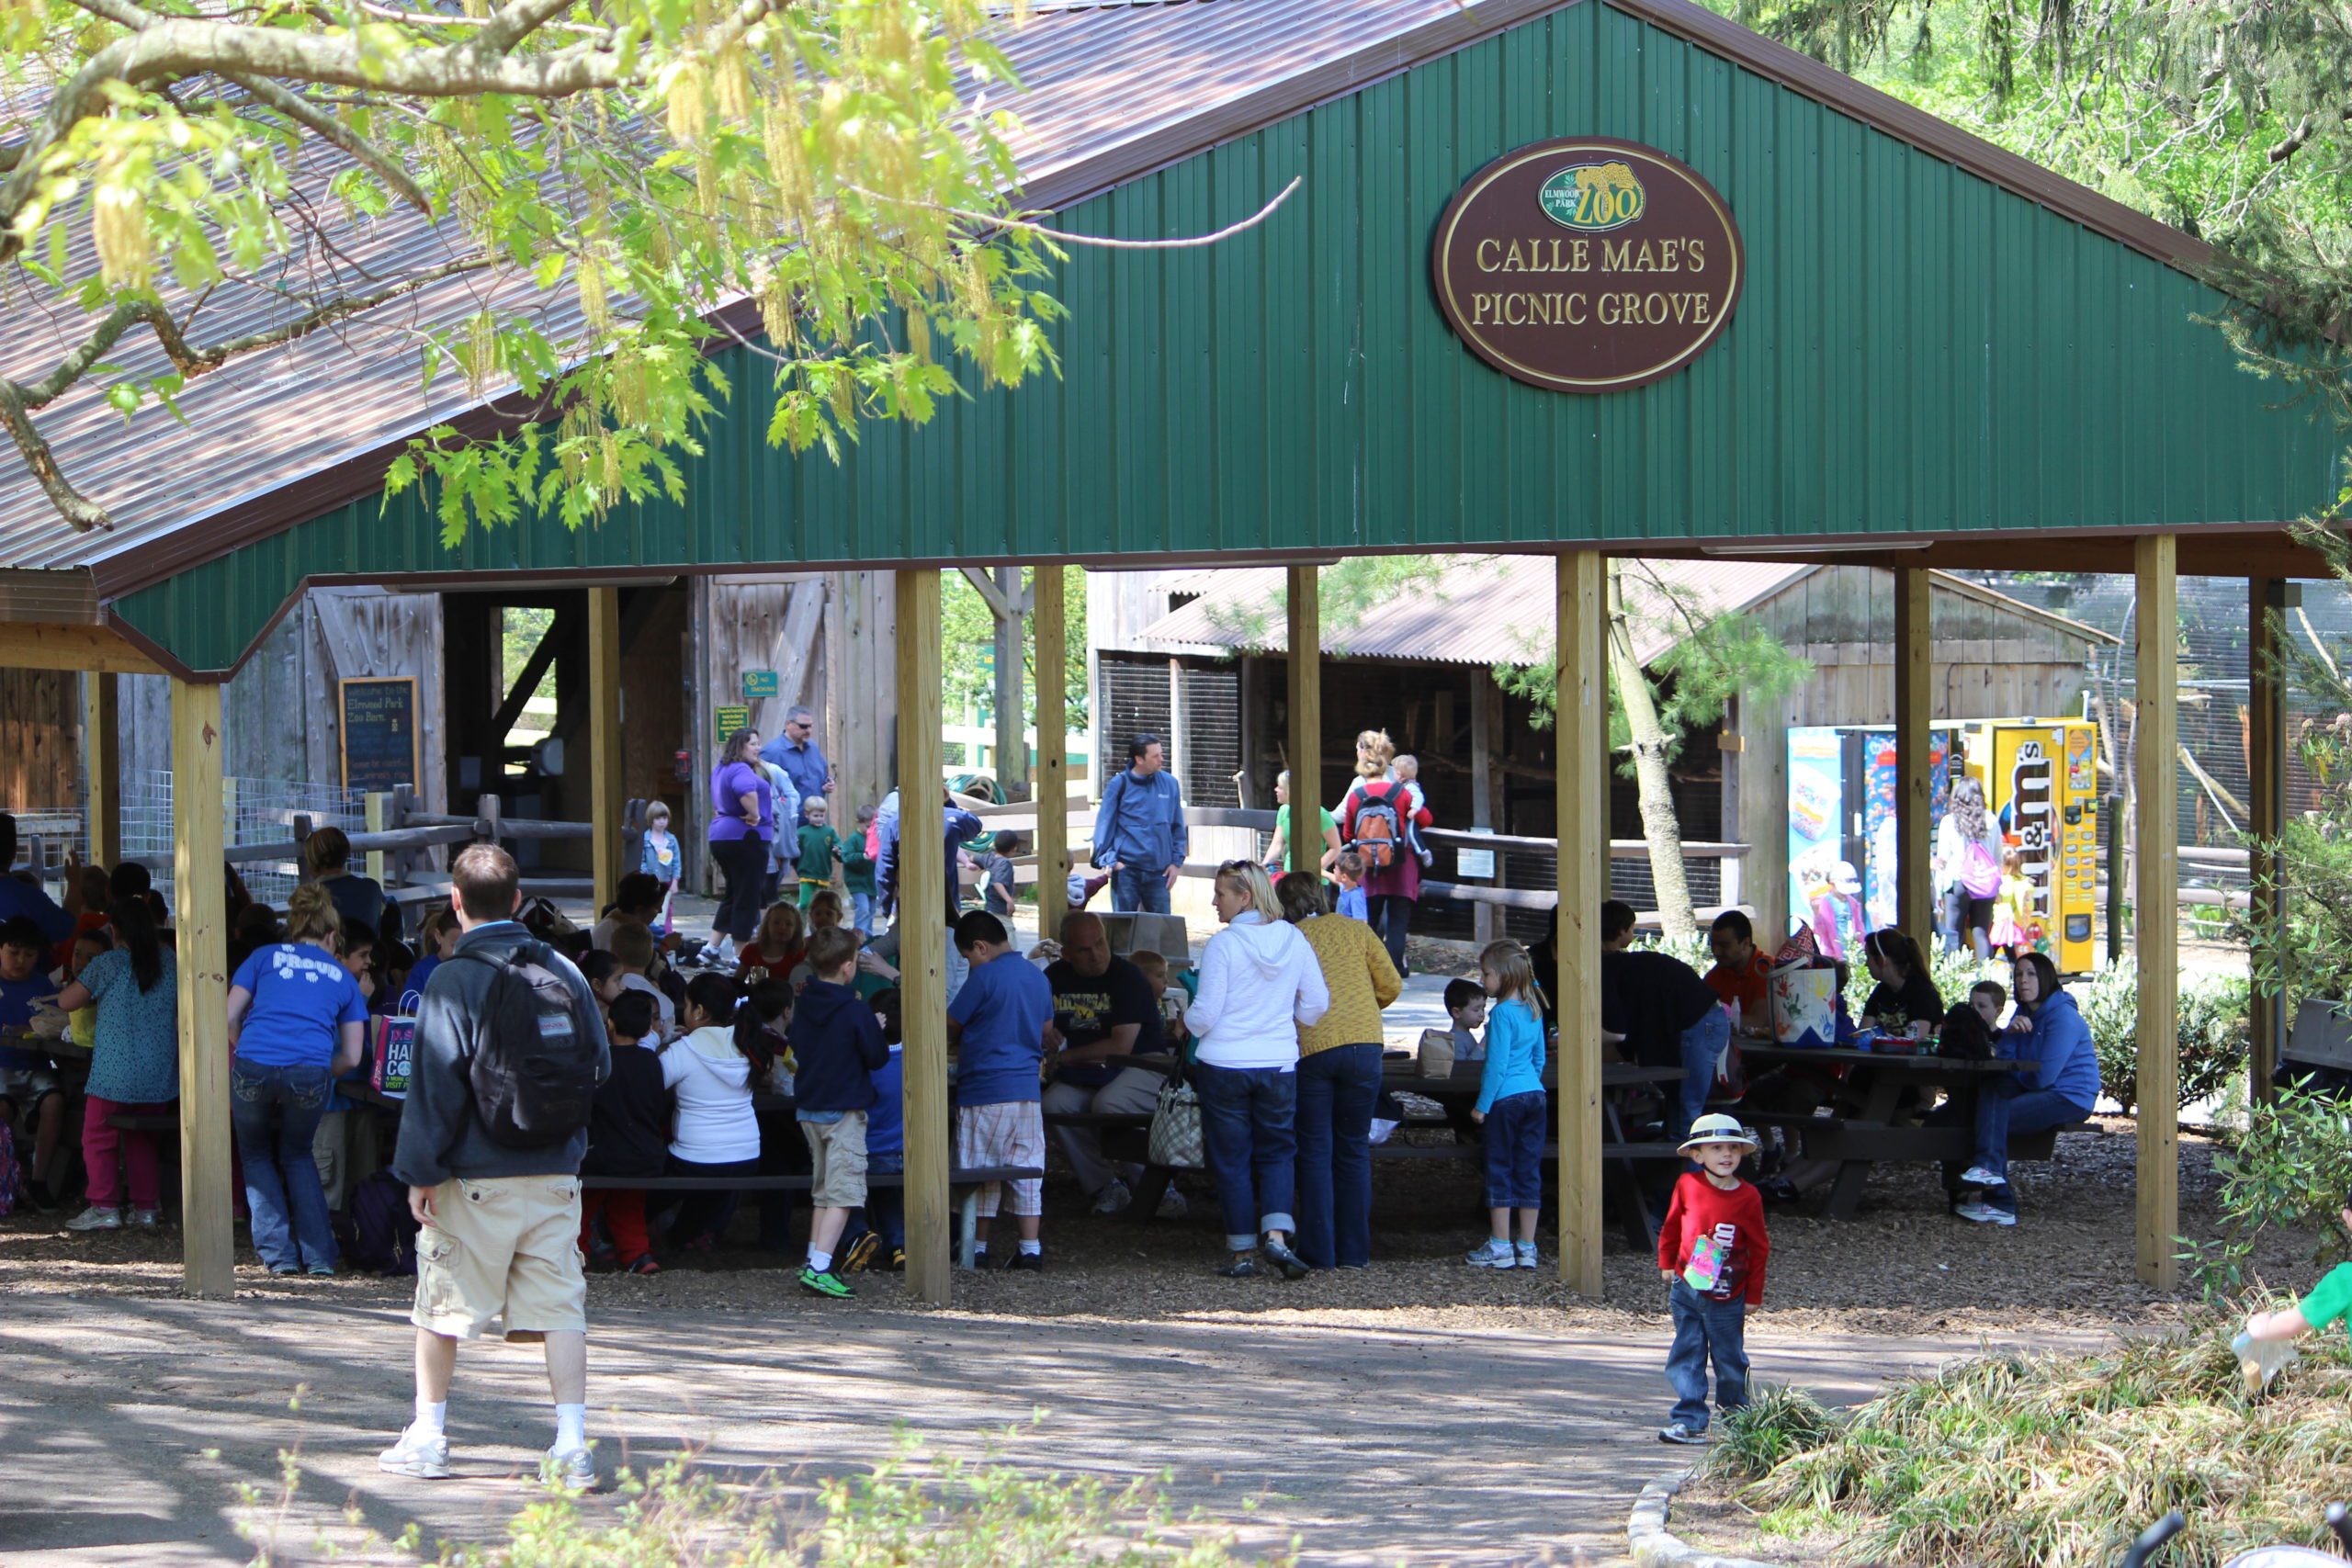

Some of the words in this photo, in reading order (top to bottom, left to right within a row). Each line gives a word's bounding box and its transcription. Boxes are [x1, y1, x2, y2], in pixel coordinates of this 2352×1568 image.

[1544, 189, 1579, 198] ELMWOOD
[1555, 199, 1577, 208] PARK
[1574, 188, 1637, 224] ZOO
[1476, 238, 1590, 273] CALLE
[1600, 236, 1705, 273] MAE'S
[1472, 292, 1587, 326] PICNIC
[1597, 292, 1711, 326] GROVE
[273, 951, 343, 983] PROUD
[388, 1043, 413, 1060] HA
